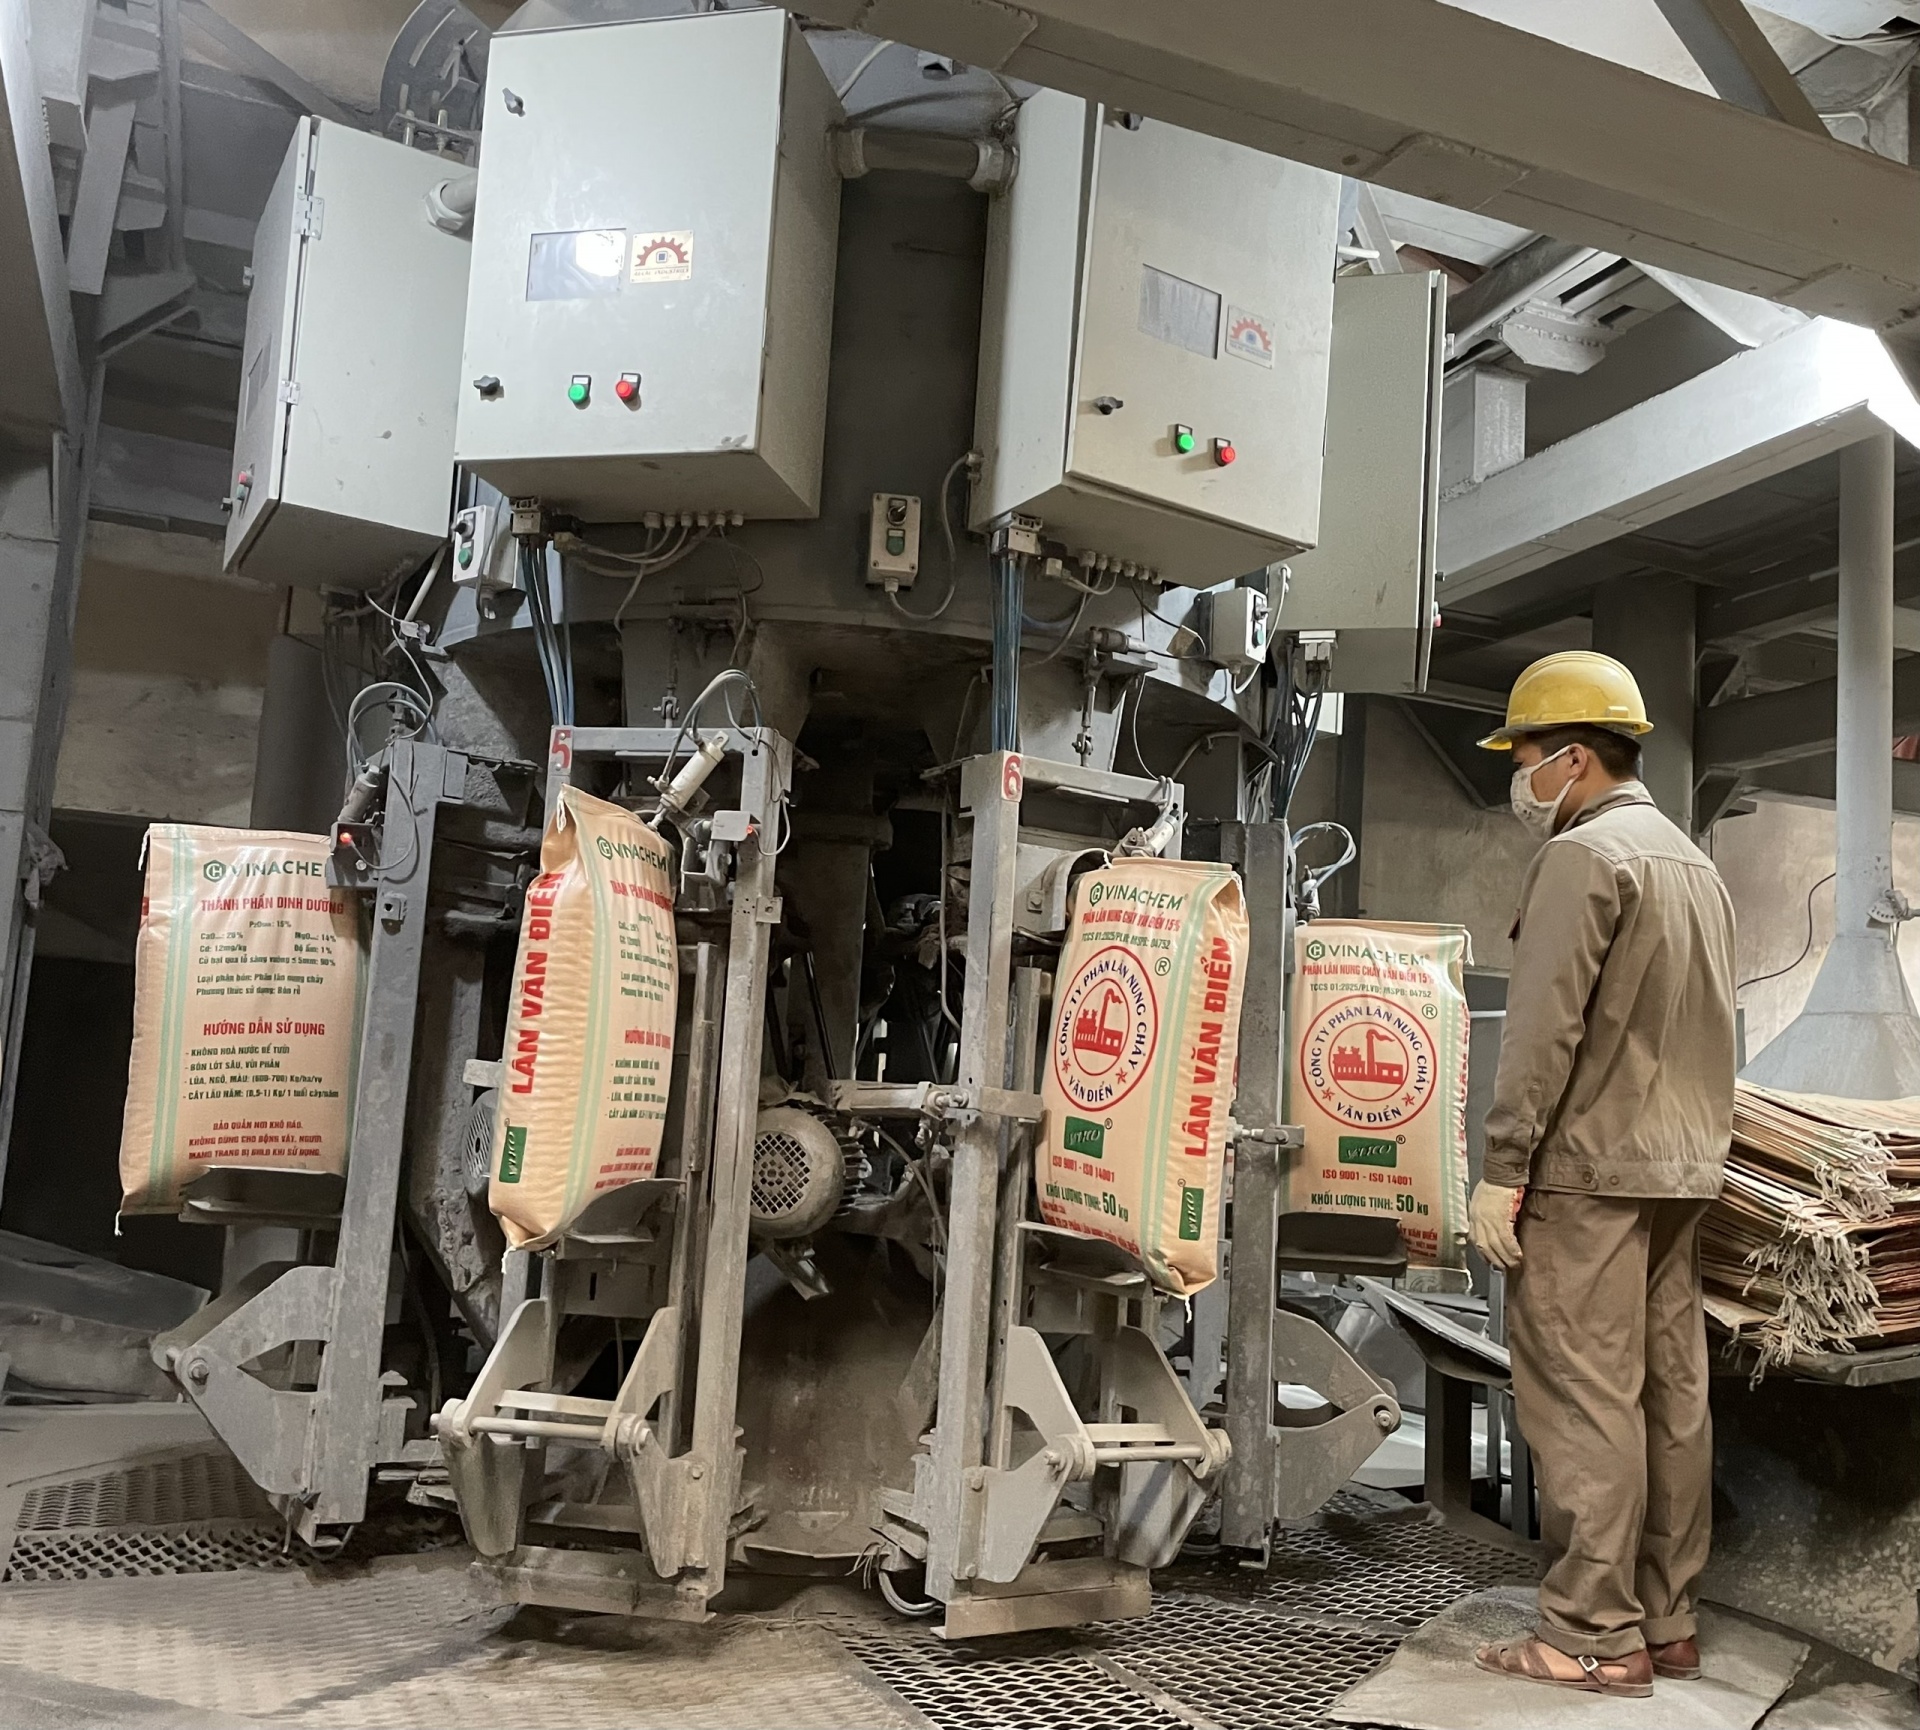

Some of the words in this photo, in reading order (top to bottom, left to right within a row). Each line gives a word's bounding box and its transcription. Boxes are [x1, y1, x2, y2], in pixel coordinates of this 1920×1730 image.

[552, 730, 571, 768] 5
[1004, 755, 1021, 798] 6
[231, 860, 326, 877] VINACHE
[612, 842, 667, 872] VINACHEM
[1106, 884, 1184, 911] VINACHEM
[1111, 959, 1130, 979] LÂN
[1324, 962, 1338, 974] LÂN
[1340, 965, 1360, 975] NUNG
[1328, 945, 1425, 965] VINACHEM
[520, 951, 549, 1019] VĂN
[1083, 959, 1110, 987] PHÂN
[1201, 936, 1232, 1013] ĐIỂN
[1310, 983, 1328, 991] TCCS
[1070, 987, 1082, 1005] TY
[1126, 975, 1147, 1016] NUNG
[203, 1019, 245, 1036] HƯỚNG
[249, 1017, 273, 1034] DẪN
[276, 1017, 293, 1034] SỬ
[294, 1022, 325, 1037] DỤNG
[1328, 1006, 1363, 1028] PHÂN
[1366, 1006, 1393, 1022] LÂN
[1058, 1010, 1072, 1057] CÔNG
[1128, 1021, 1147, 1070] CHẢY
[1315, 1027, 1330, 1044] TY
[1393, 1017, 1422, 1051] NUNG
[512, 1029, 541, 1094] LÂN
[1191, 1021, 1223, 1086] VĂN
[1309, 1047, 1325, 1087] CÔNG
[1068, 1075, 1085, 1100] VĂN
[1087, 1080, 1114, 1102] ĐIỂN
[1414, 1055, 1430, 1094] CHẢY
[1181, 1094, 1213, 1157] LÂN
[1336, 1102, 1363, 1121] VĂN
[1367, 1105, 1402, 1122] ĐIỂN
[1322, 1169, 1337, 1179] ISO
[1340, 1170, 1359, 1180] 9001
[1369, 1173, 1383, 1183] ISO
[1387, 1175, 1413, 1186] 14001
[1102, 1191, 1116, 1216] 50
[1118, 1203, 1129, 1223] kg
[1311, 1189, 1333, 1206] KHỐI
[1335, 1194, 1366, 1209] LƯỢNG
[1396, 1194, 1414, 1213] 50
[1417, 1202, 1429, 1216] kg
